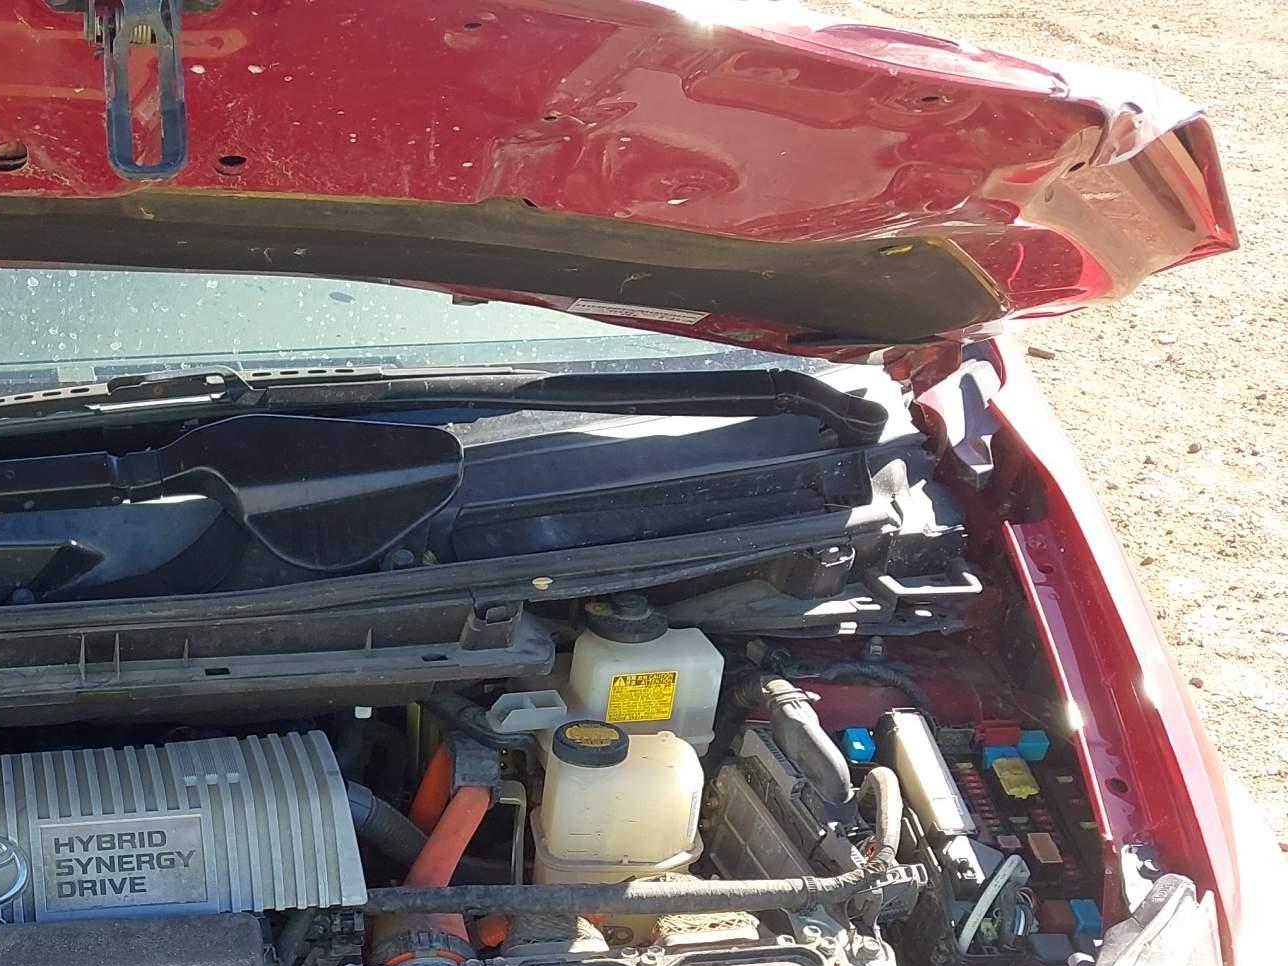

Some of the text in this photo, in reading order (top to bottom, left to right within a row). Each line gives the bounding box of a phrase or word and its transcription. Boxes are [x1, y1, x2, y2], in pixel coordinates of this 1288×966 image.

[54, 830, 167, 854] HYBRID
[55, 850, 196, 876] SYNERGY
[56, 876, 147, 898] DRIVE
